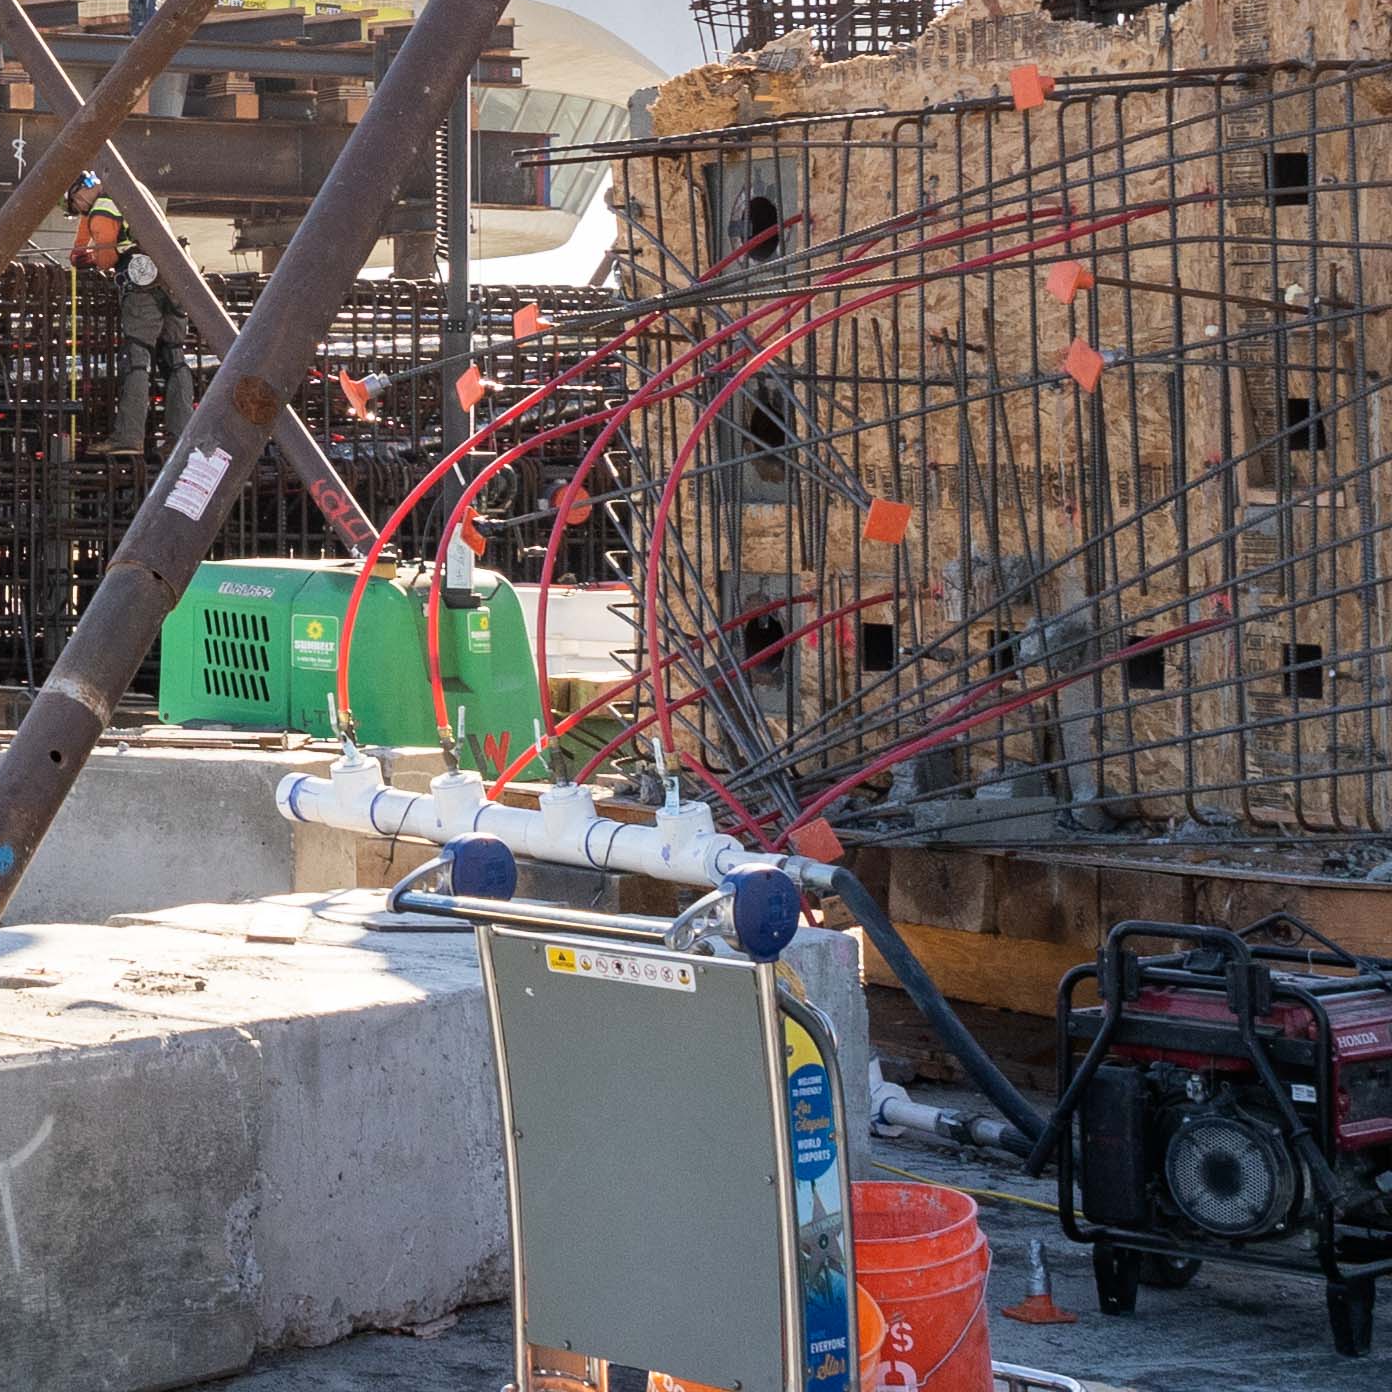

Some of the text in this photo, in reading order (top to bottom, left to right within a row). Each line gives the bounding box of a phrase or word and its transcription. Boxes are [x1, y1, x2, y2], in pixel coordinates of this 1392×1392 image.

[1336, 1031, 1379, 1049] HONDA
[797, 1137, 822, 1150] WORLD
[798, 1149, 831, 1164] AIRPORTS
[810, 1336, 847, 1354] EVERYONE
